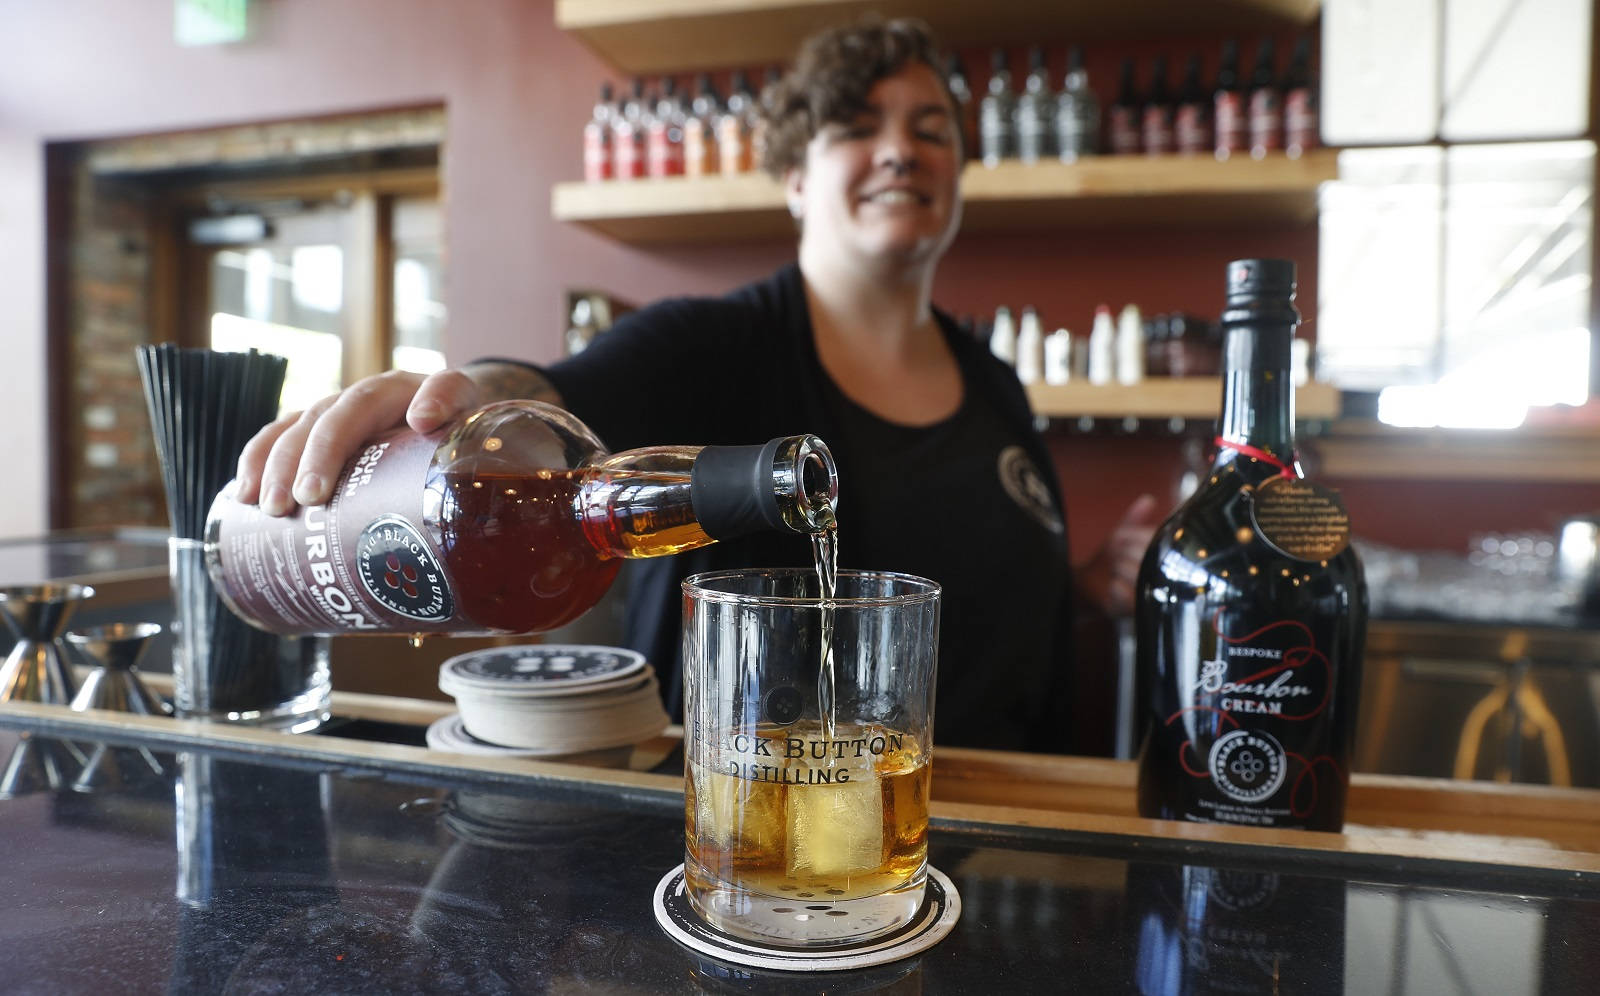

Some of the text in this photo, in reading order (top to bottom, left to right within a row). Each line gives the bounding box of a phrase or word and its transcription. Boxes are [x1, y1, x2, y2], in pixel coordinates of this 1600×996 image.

[345, 447, 377, 497] GRAIN
[358, 442, 391, 487] FOUR
[304, 505, 379, 630] URBON
[362, 536, 407, 613] DISTILLING
[383, 529, 443, 616] BLACK BUTTON
[1228, 646, 1283, 659] BESPOKE
[1192, 659, 1312, 700] Bourbon
[1220, 700, 1283, 715] CREAM
[783, 733, 904, 760] BUTTON
[729, 760, 850, 785] DISTILLING
